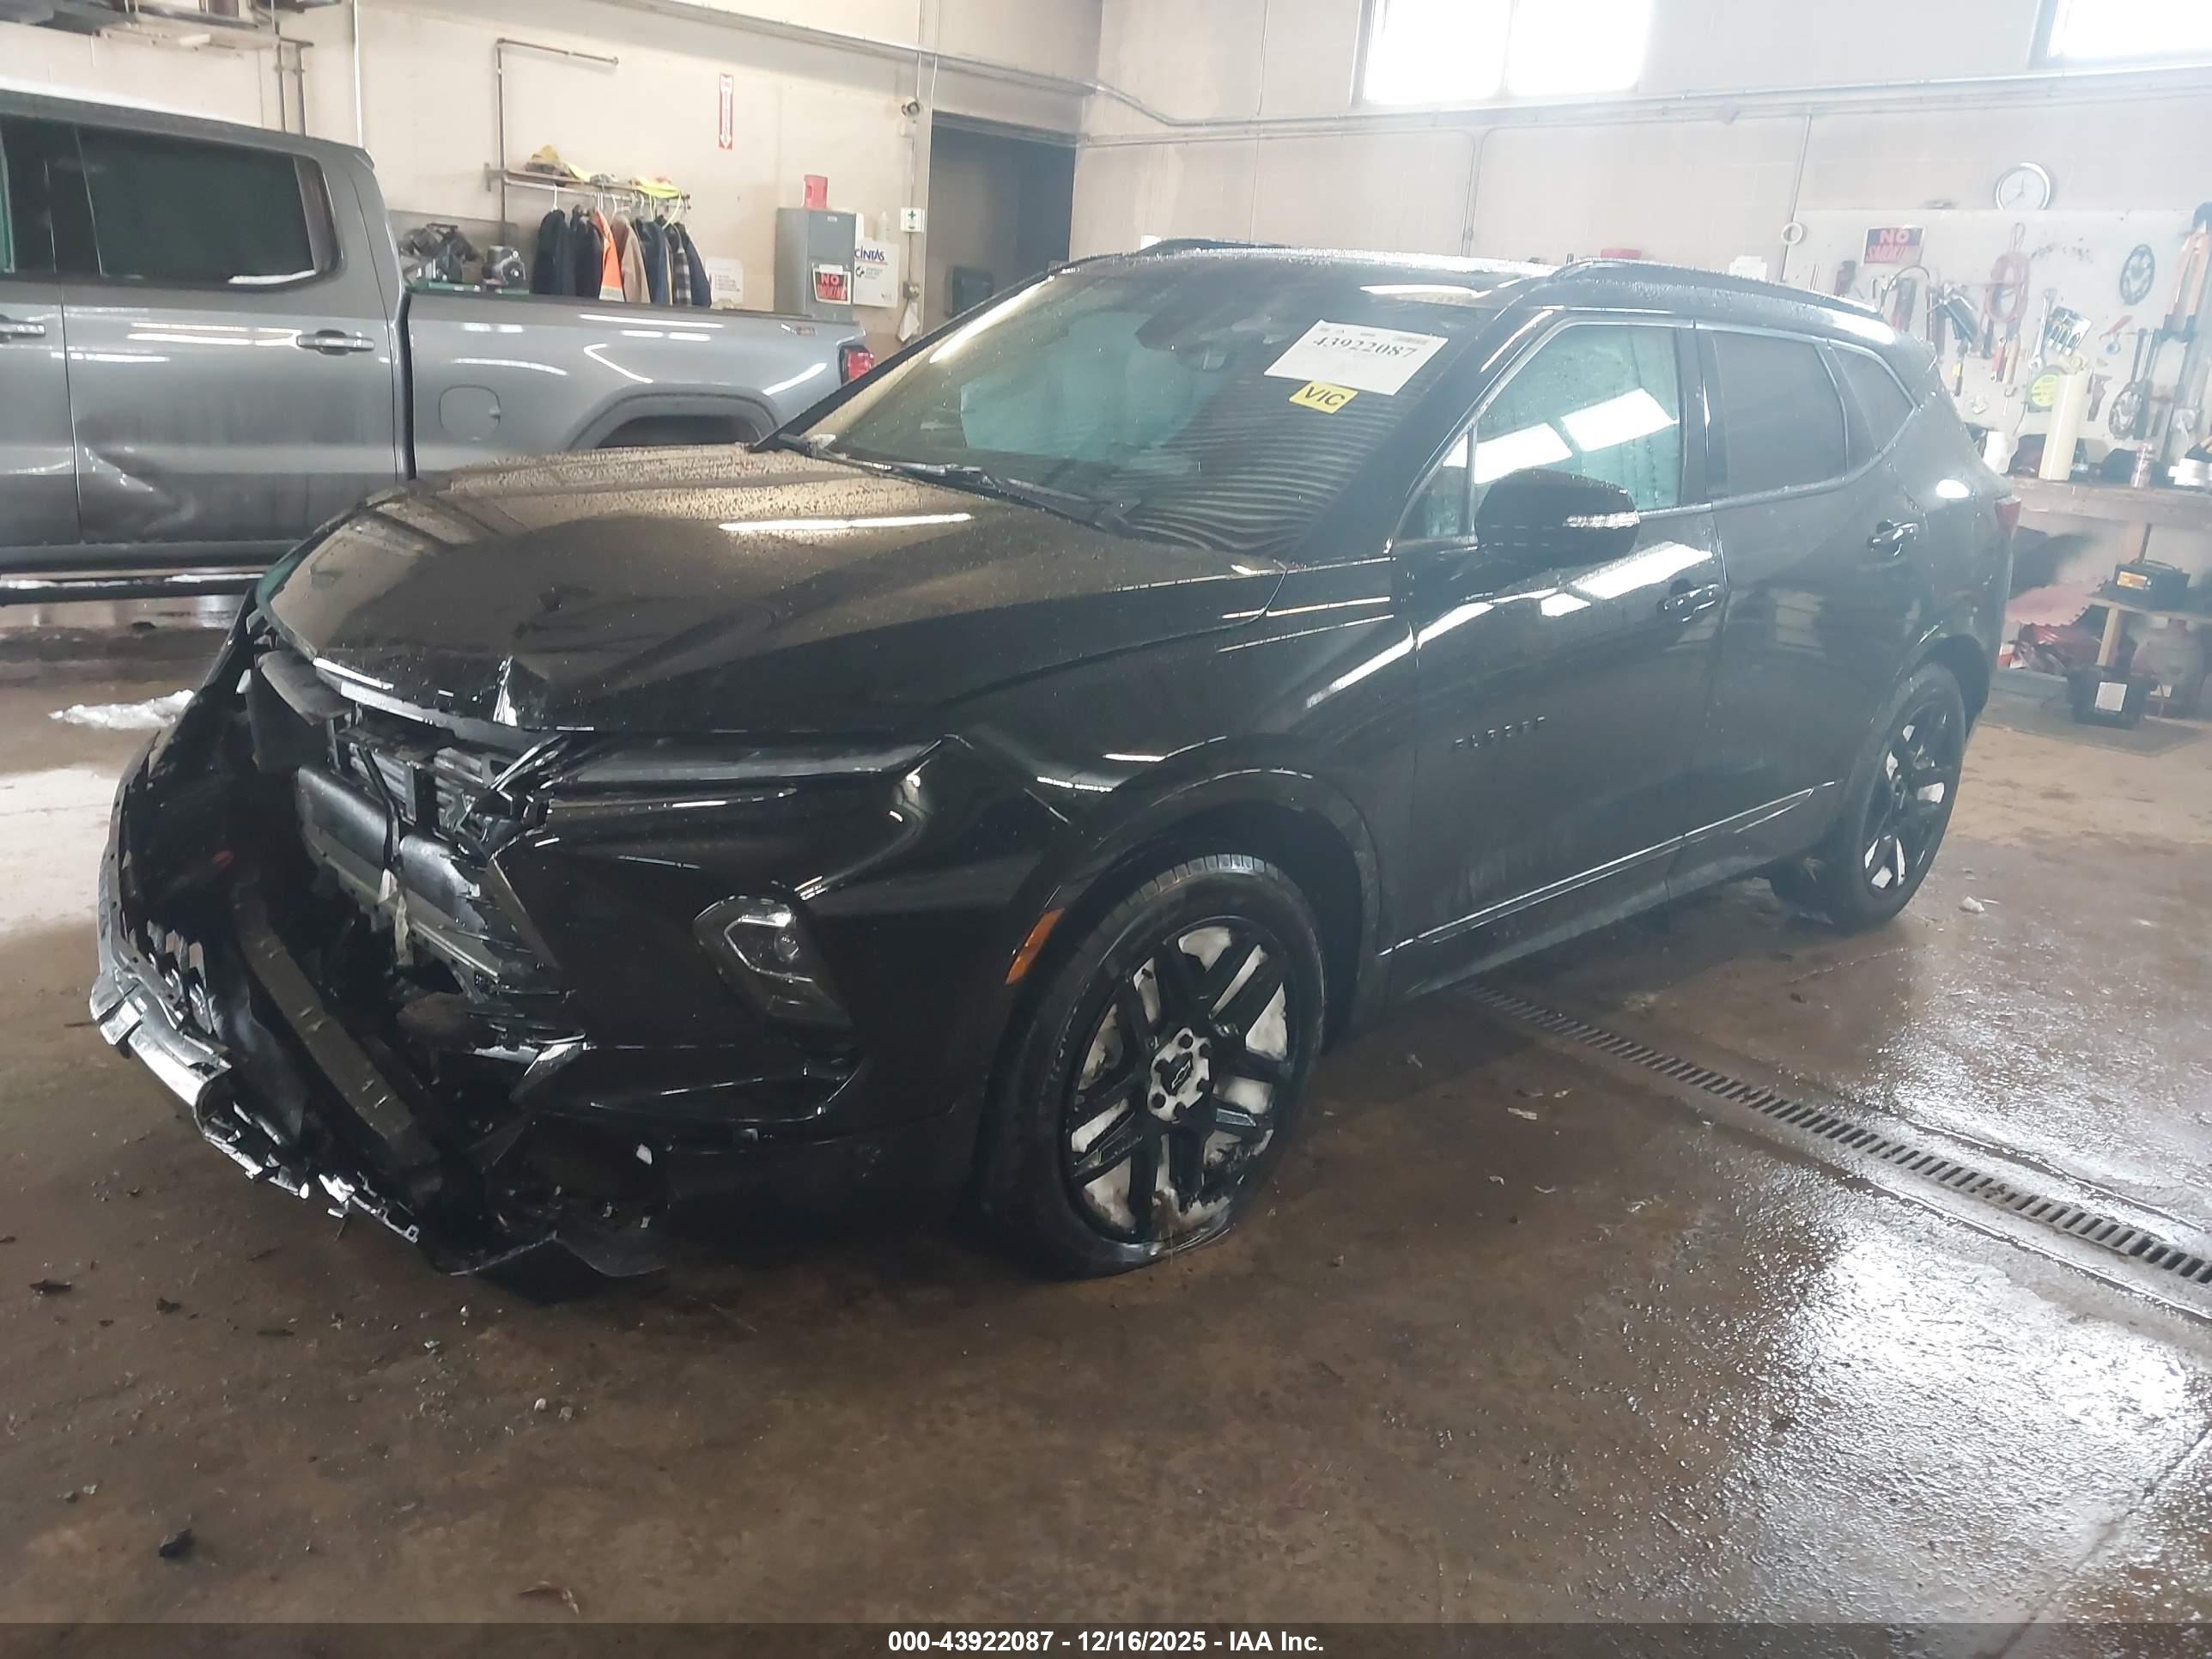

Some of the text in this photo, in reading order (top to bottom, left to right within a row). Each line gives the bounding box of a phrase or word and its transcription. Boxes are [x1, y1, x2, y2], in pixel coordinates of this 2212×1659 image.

[1880, 228, 1910, 246] NO
[821, 274, 840, 285] NO
[1313, 336, 1418, 358] 43922087
[1304, 386, 1346, 406] VIC
